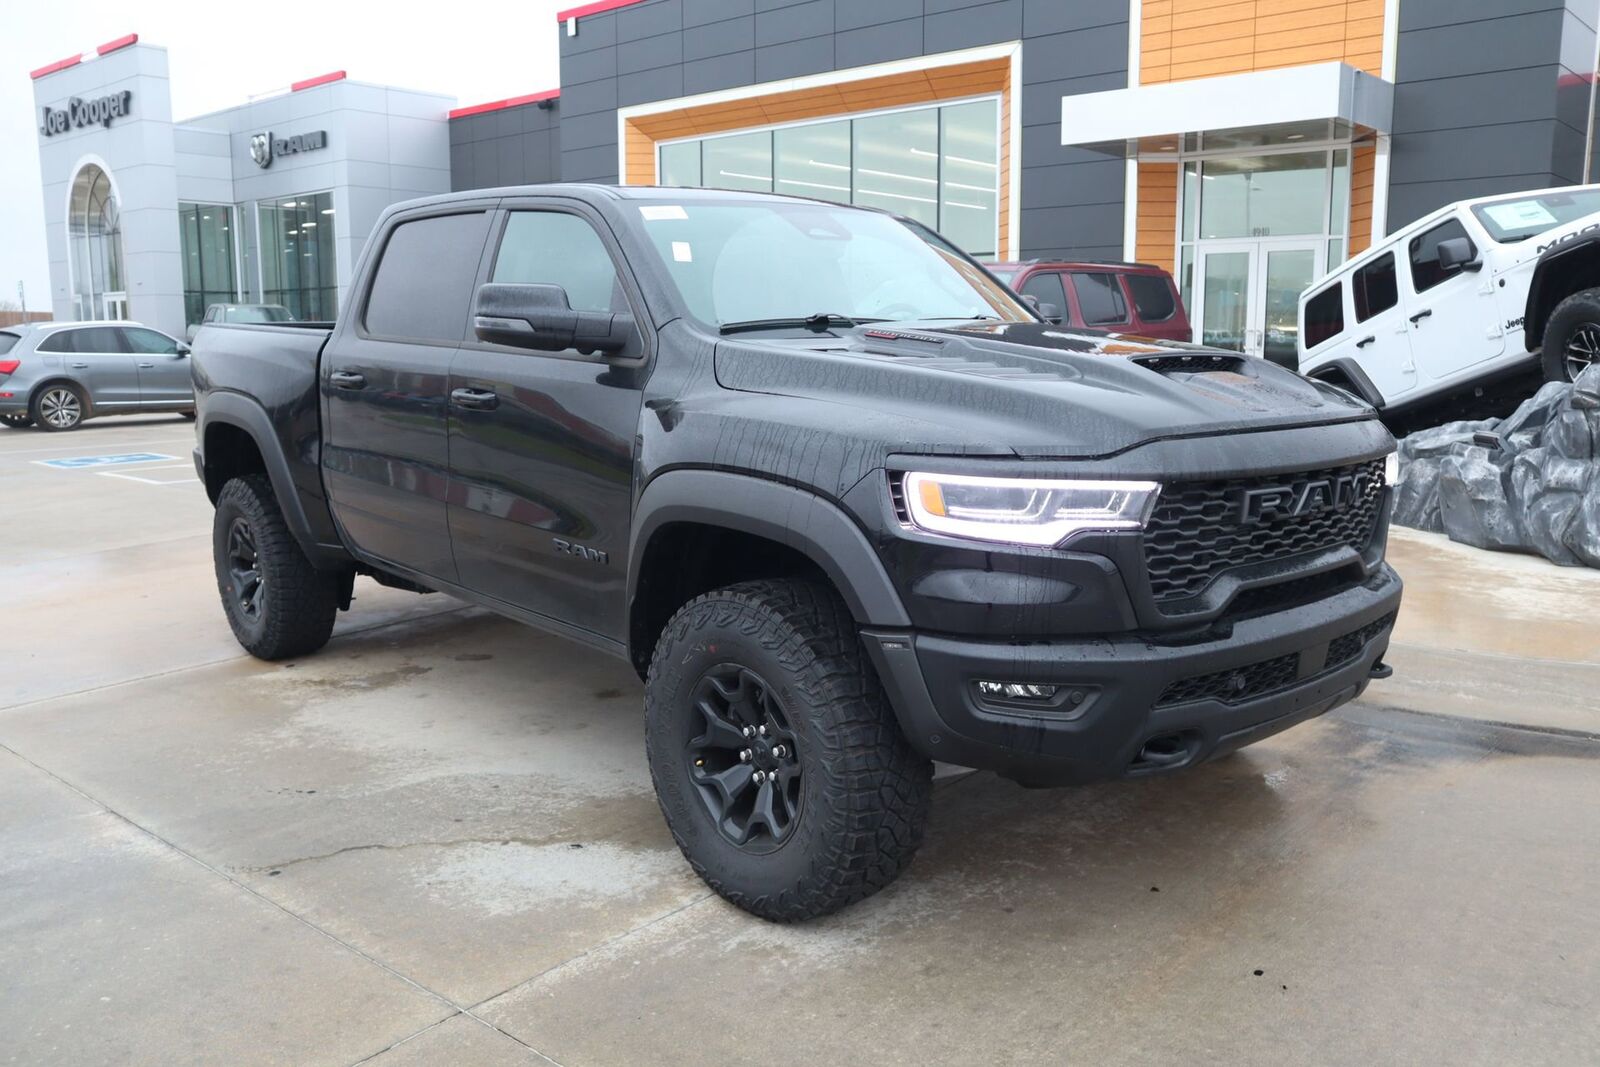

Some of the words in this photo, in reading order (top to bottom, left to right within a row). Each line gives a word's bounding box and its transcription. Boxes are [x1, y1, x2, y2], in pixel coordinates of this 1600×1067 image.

[40, 106, 69, 136] Joe
[68, 90, 131, 129] Cooper
[1505, 316, 1525, 330] Jeep
[1242, 471, 1368, 524] RAM
[552, 538, 609, 565] RAM
